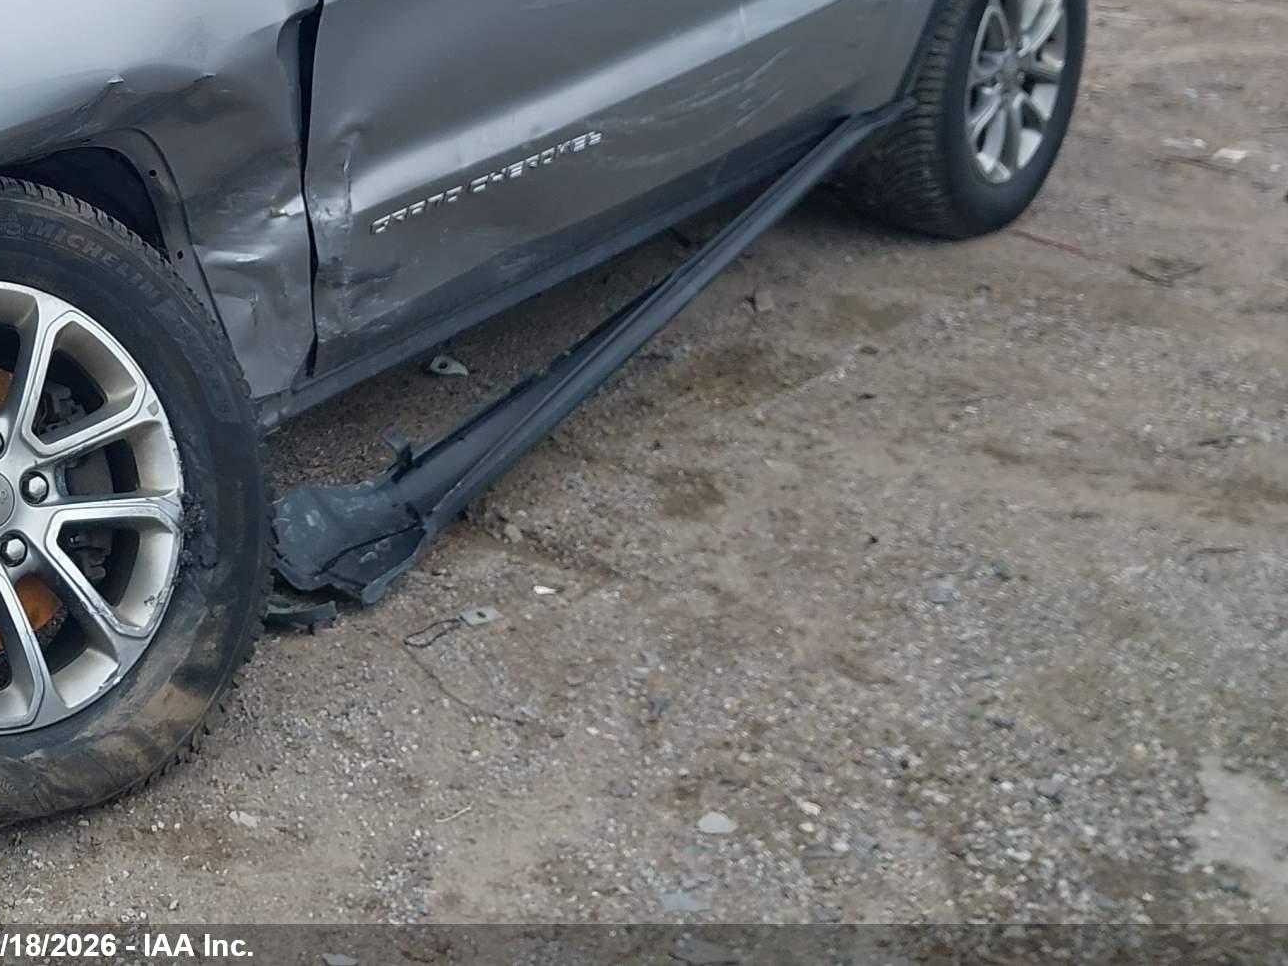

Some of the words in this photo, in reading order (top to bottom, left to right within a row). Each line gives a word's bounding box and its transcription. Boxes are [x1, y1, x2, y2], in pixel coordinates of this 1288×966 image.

[369, 185, 464, 235] GRAND
[467, 130, 602, 194] CHEROKEE
[30, 217, 162, 301] MICHELIN
